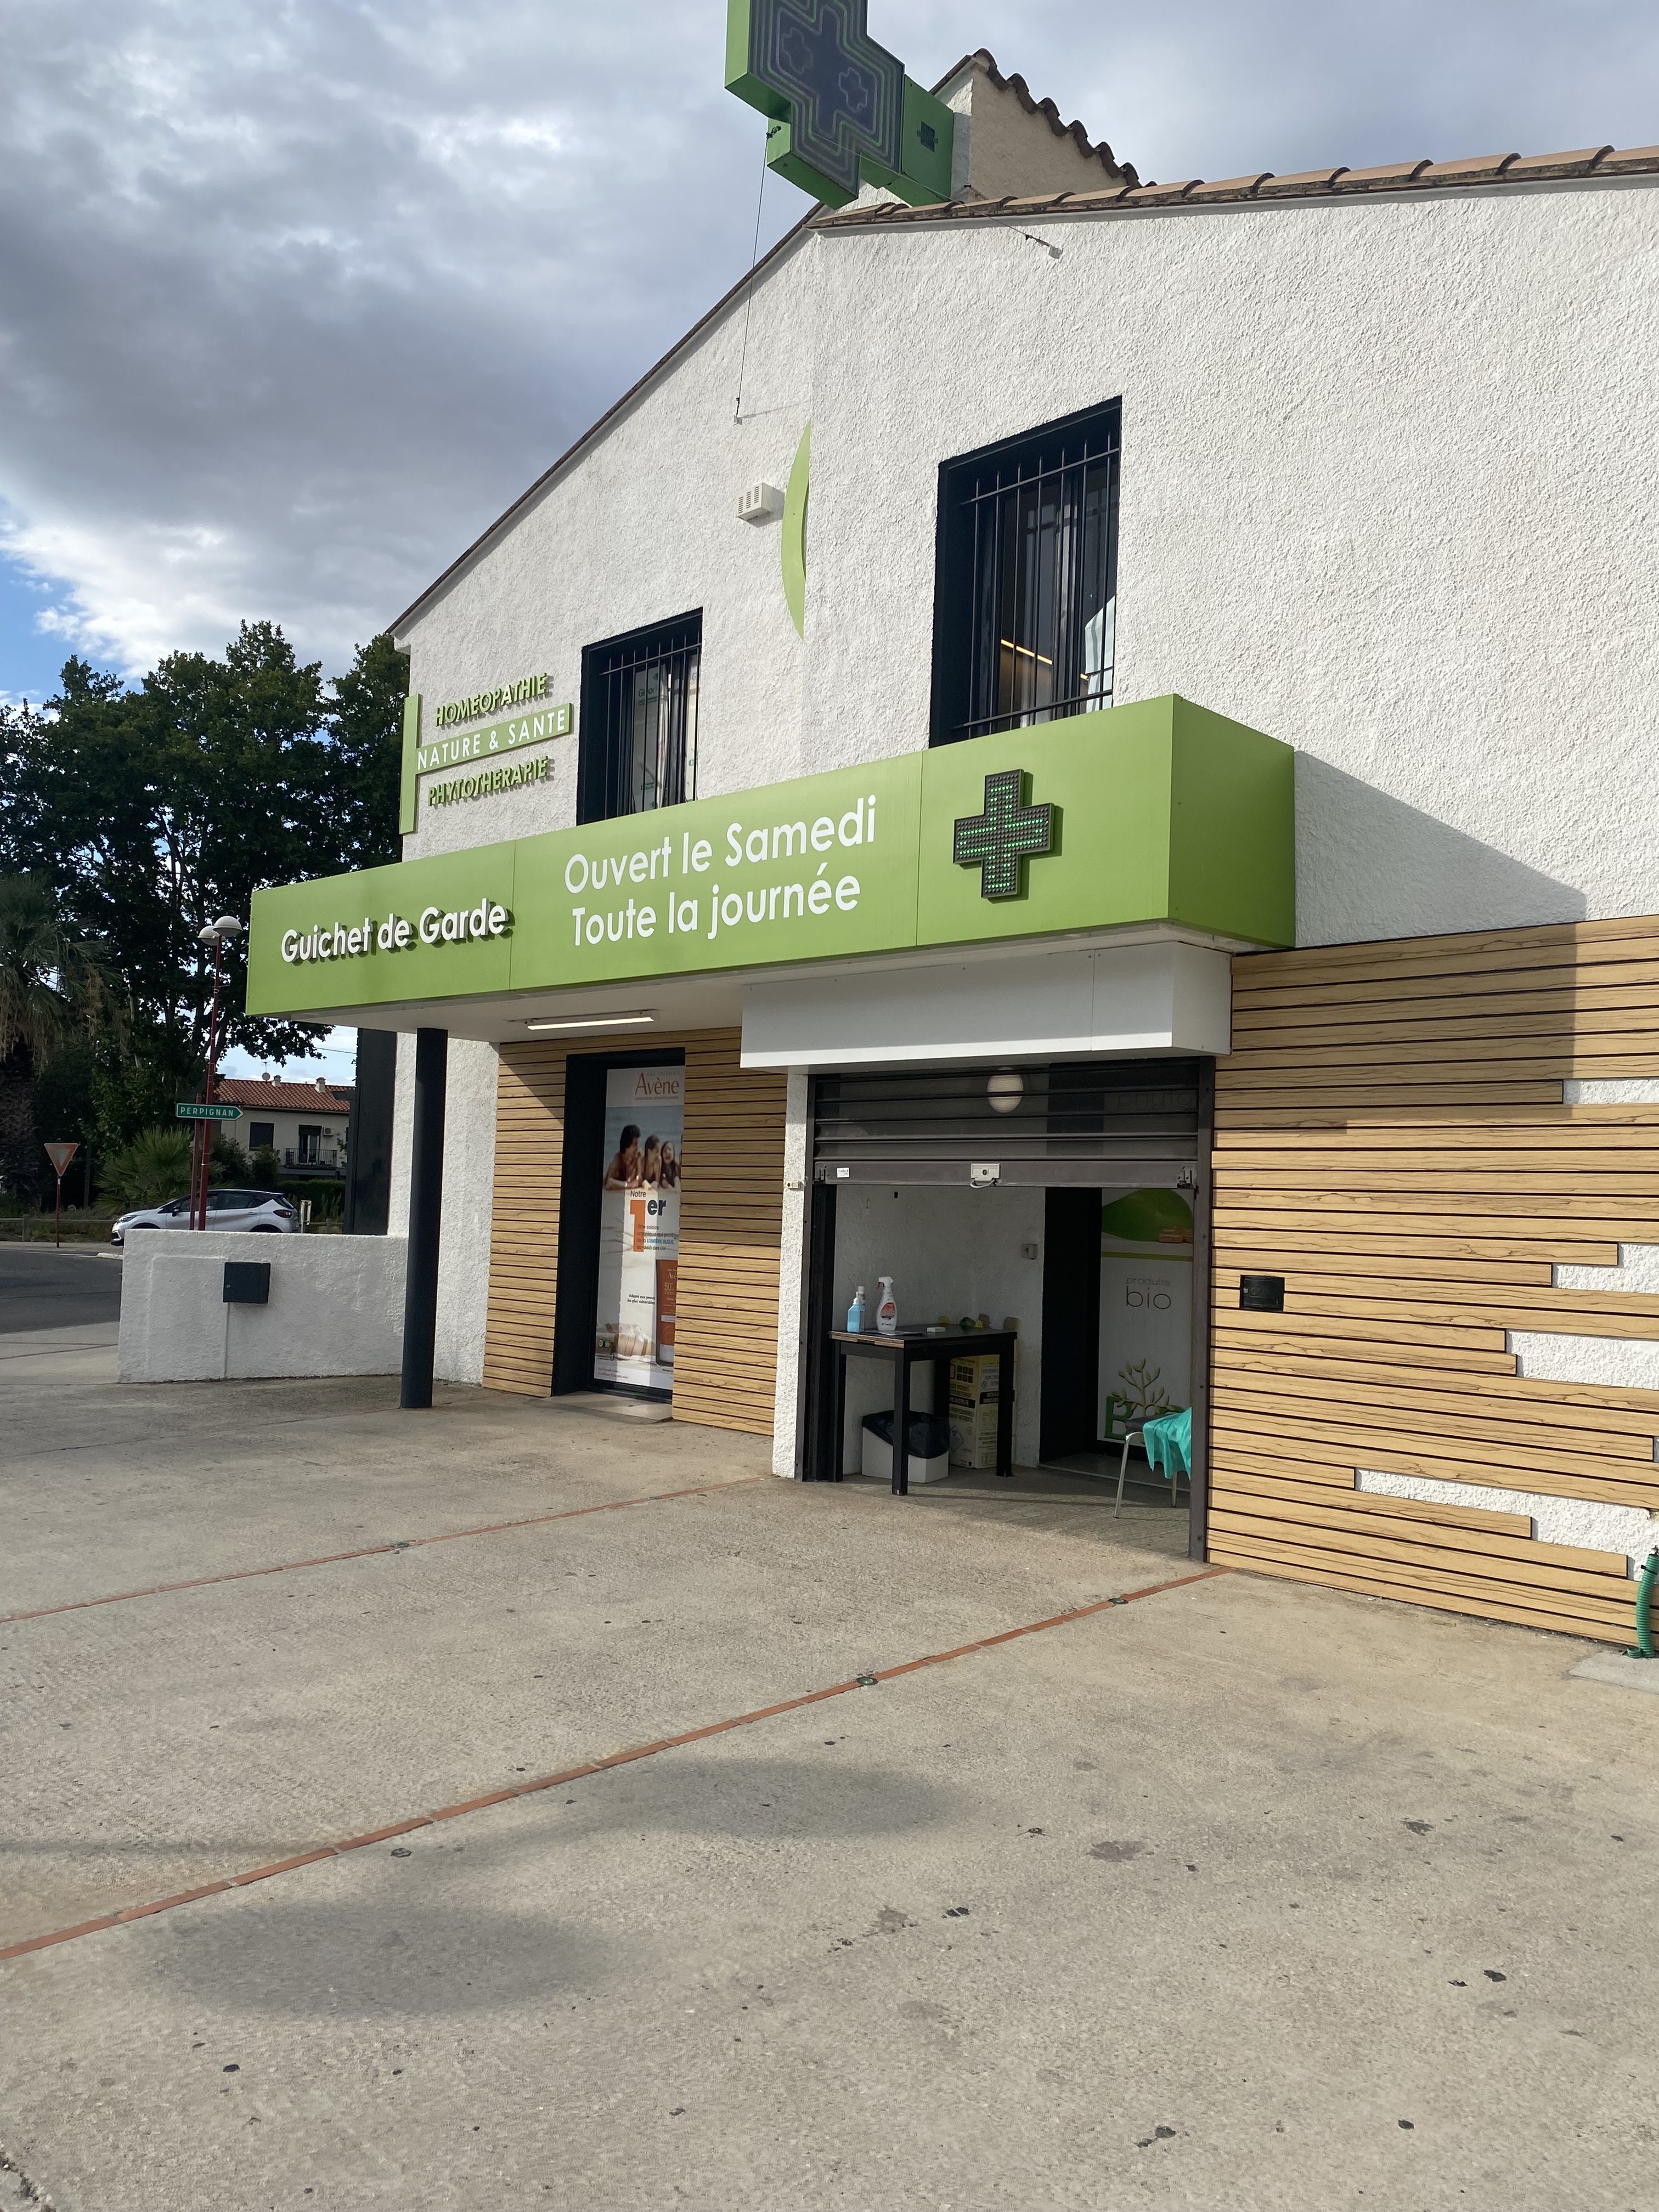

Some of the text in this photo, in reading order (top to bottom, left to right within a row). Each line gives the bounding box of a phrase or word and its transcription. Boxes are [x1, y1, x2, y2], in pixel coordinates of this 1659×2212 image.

[436, 673, 549, 727] HOMEOPATHIE
[417, 709, 565, 770] NATURE & SANTE
[428, 755, 549, 806] PHYTOTHERAPIE
[565, 794, 877, 894] Ouvert le Samedi
[572, 862, 860, 946] Toute la journée
[281, 898, 509, 963] Guichet de Garde
[635, 1072, 679, 1095] Avène
[180, 1107, 233, 1116] PERPIGNAN
[1126, 1277, 1171, 1286] produits
[1126, 1286, 1172, 1310] bio
